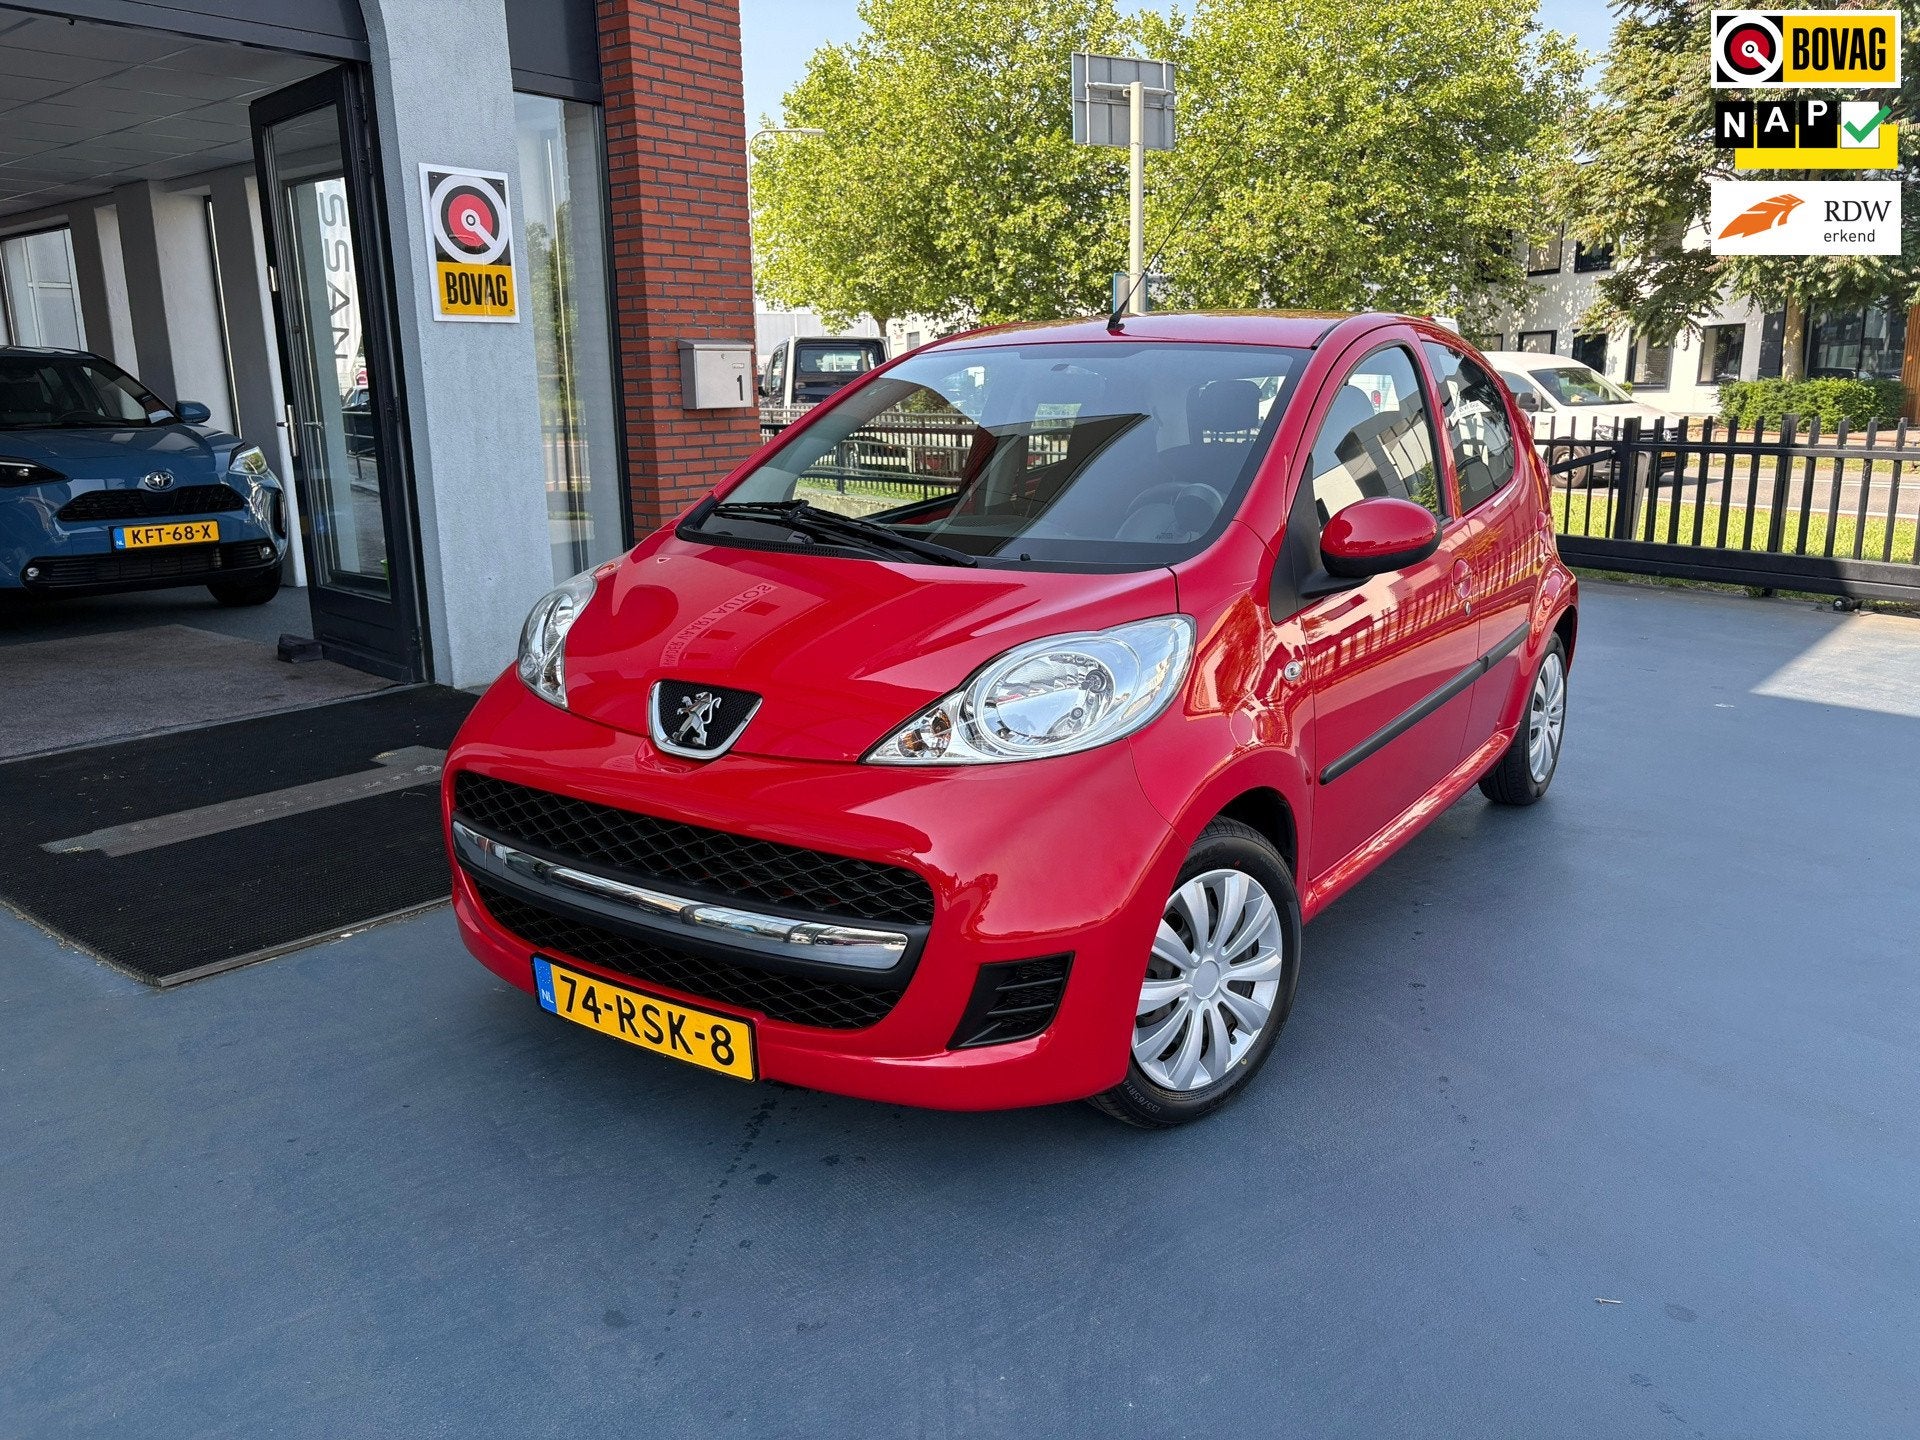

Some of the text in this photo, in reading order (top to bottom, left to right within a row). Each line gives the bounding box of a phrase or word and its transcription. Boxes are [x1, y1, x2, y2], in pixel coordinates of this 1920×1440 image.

[319, 179, 350, 360] SSAN
[445, 272, 508, 306] BOVAG
[736, 375, 743, 401] 1
[131, 525, 212, 544] KFT-68-X
[541, 989, 554, 1004] NL
[559, 974, 735, 1066] 74-RSK-8
